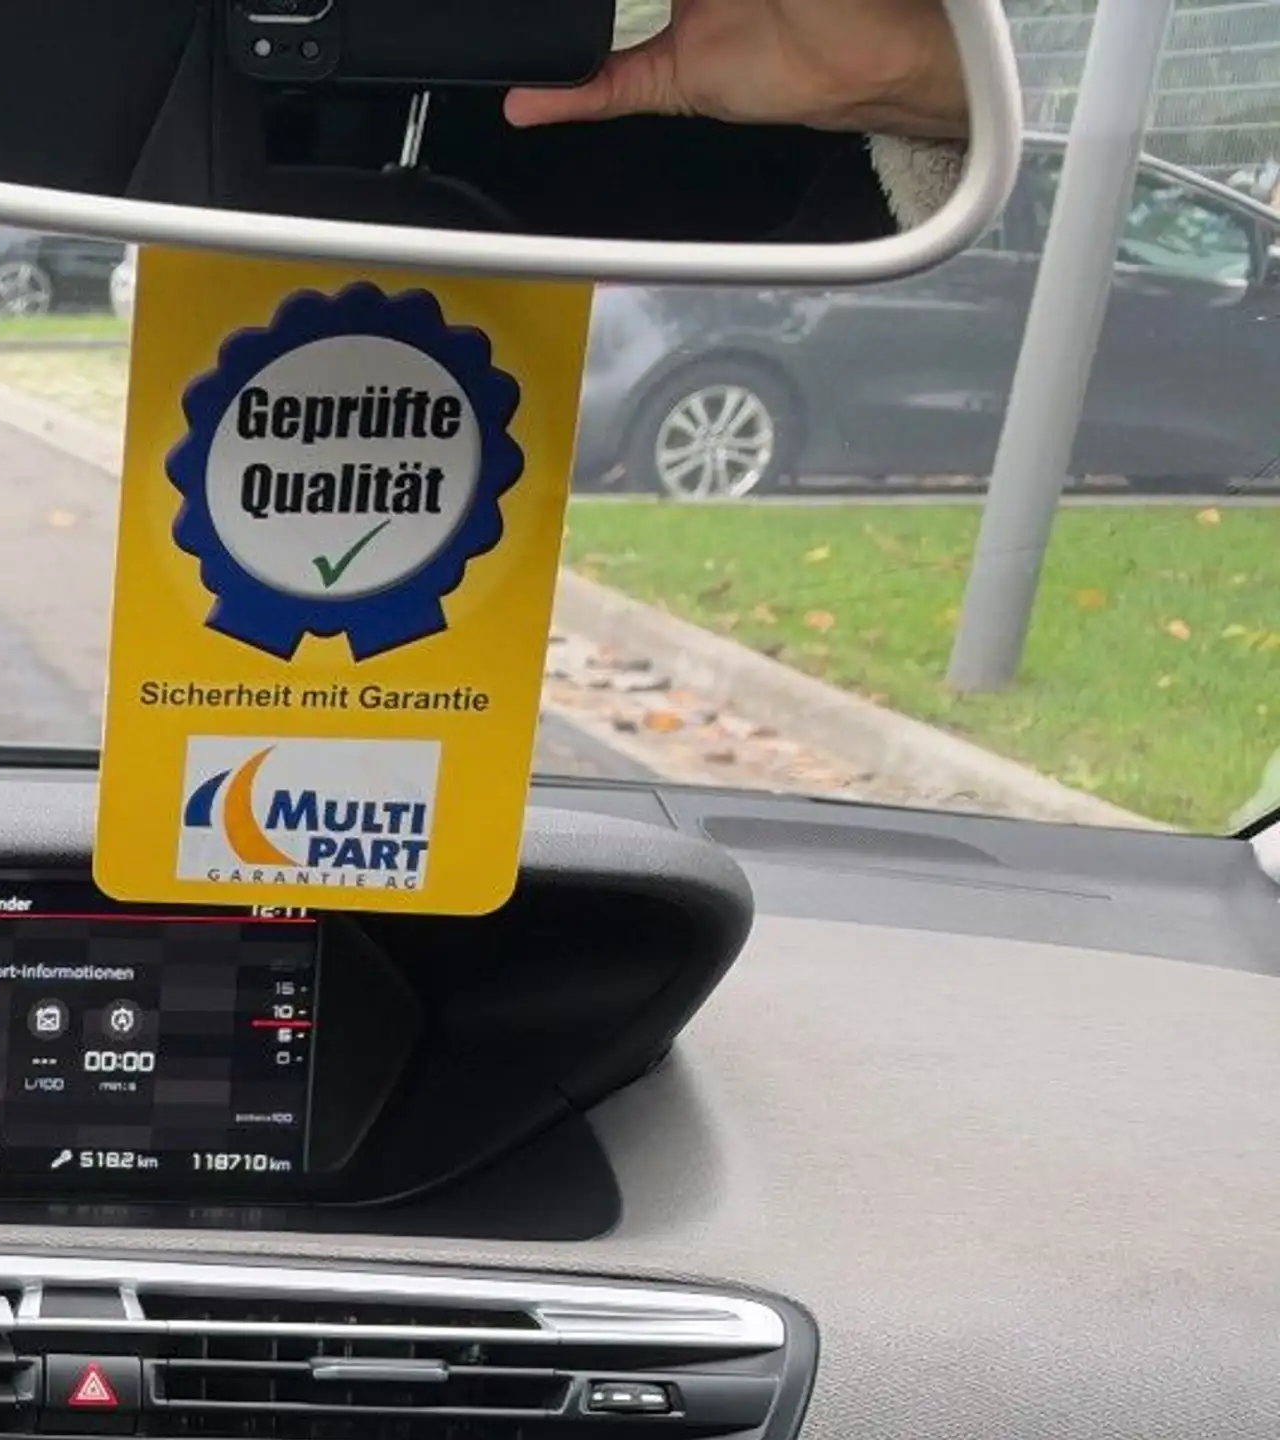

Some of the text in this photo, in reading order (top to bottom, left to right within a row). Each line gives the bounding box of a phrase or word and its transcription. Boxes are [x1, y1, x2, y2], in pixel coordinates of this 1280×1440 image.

[237, 384, 462, 446] Geprüfte
[239, 461, 445, 518] Qualität
[140, 681, 490, 712] Sicherheit mit Garantie
[264, 789, 427, 835] MULTI
[307, 836, 430, 873] PART
[207, 868, 417, 890] GARANTIE AG
[84, 1052, 155, 1072] 00:00
[137, 1155, 159, 1170] km
[191, 1153, 292, 1173] 118710 km
